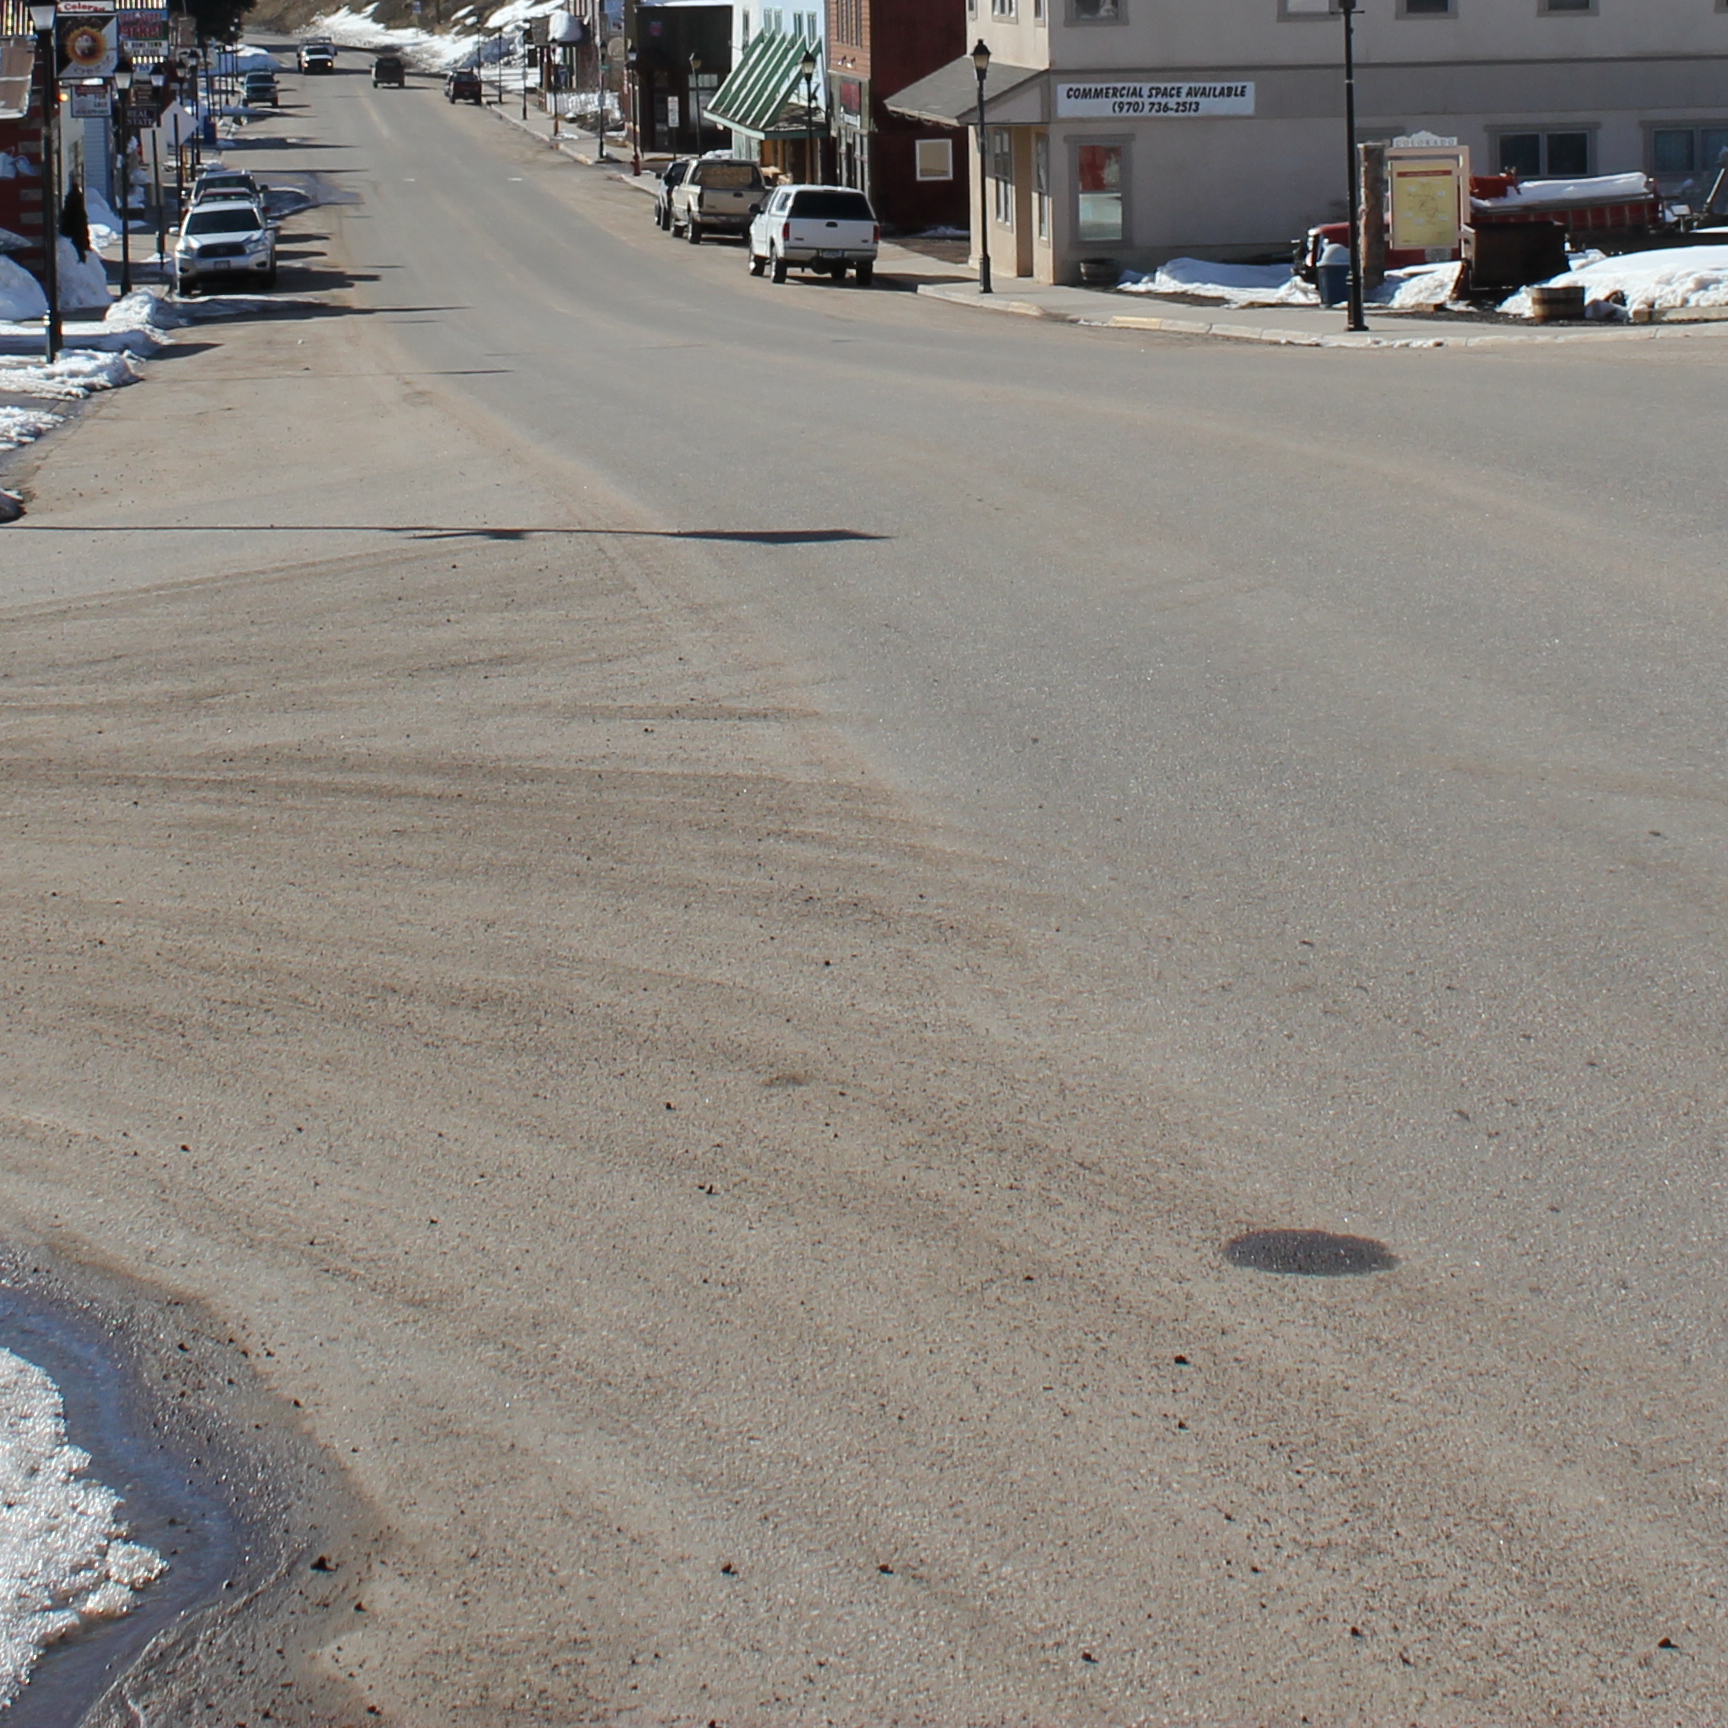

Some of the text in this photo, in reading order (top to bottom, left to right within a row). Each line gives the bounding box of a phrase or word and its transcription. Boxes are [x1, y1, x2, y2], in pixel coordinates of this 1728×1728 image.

[63, 2, 107, 12] Colorad
[120, 23, 163, 39] arket
[1066, 85, 1247, 100] COMMERCIAL SPACE AVAILABLE
[1112, 101, 1200, 114] (970) 736-2513
[126, 118, 153, 126] STATE
[1395, 139, 1455, 147] COLORADO
